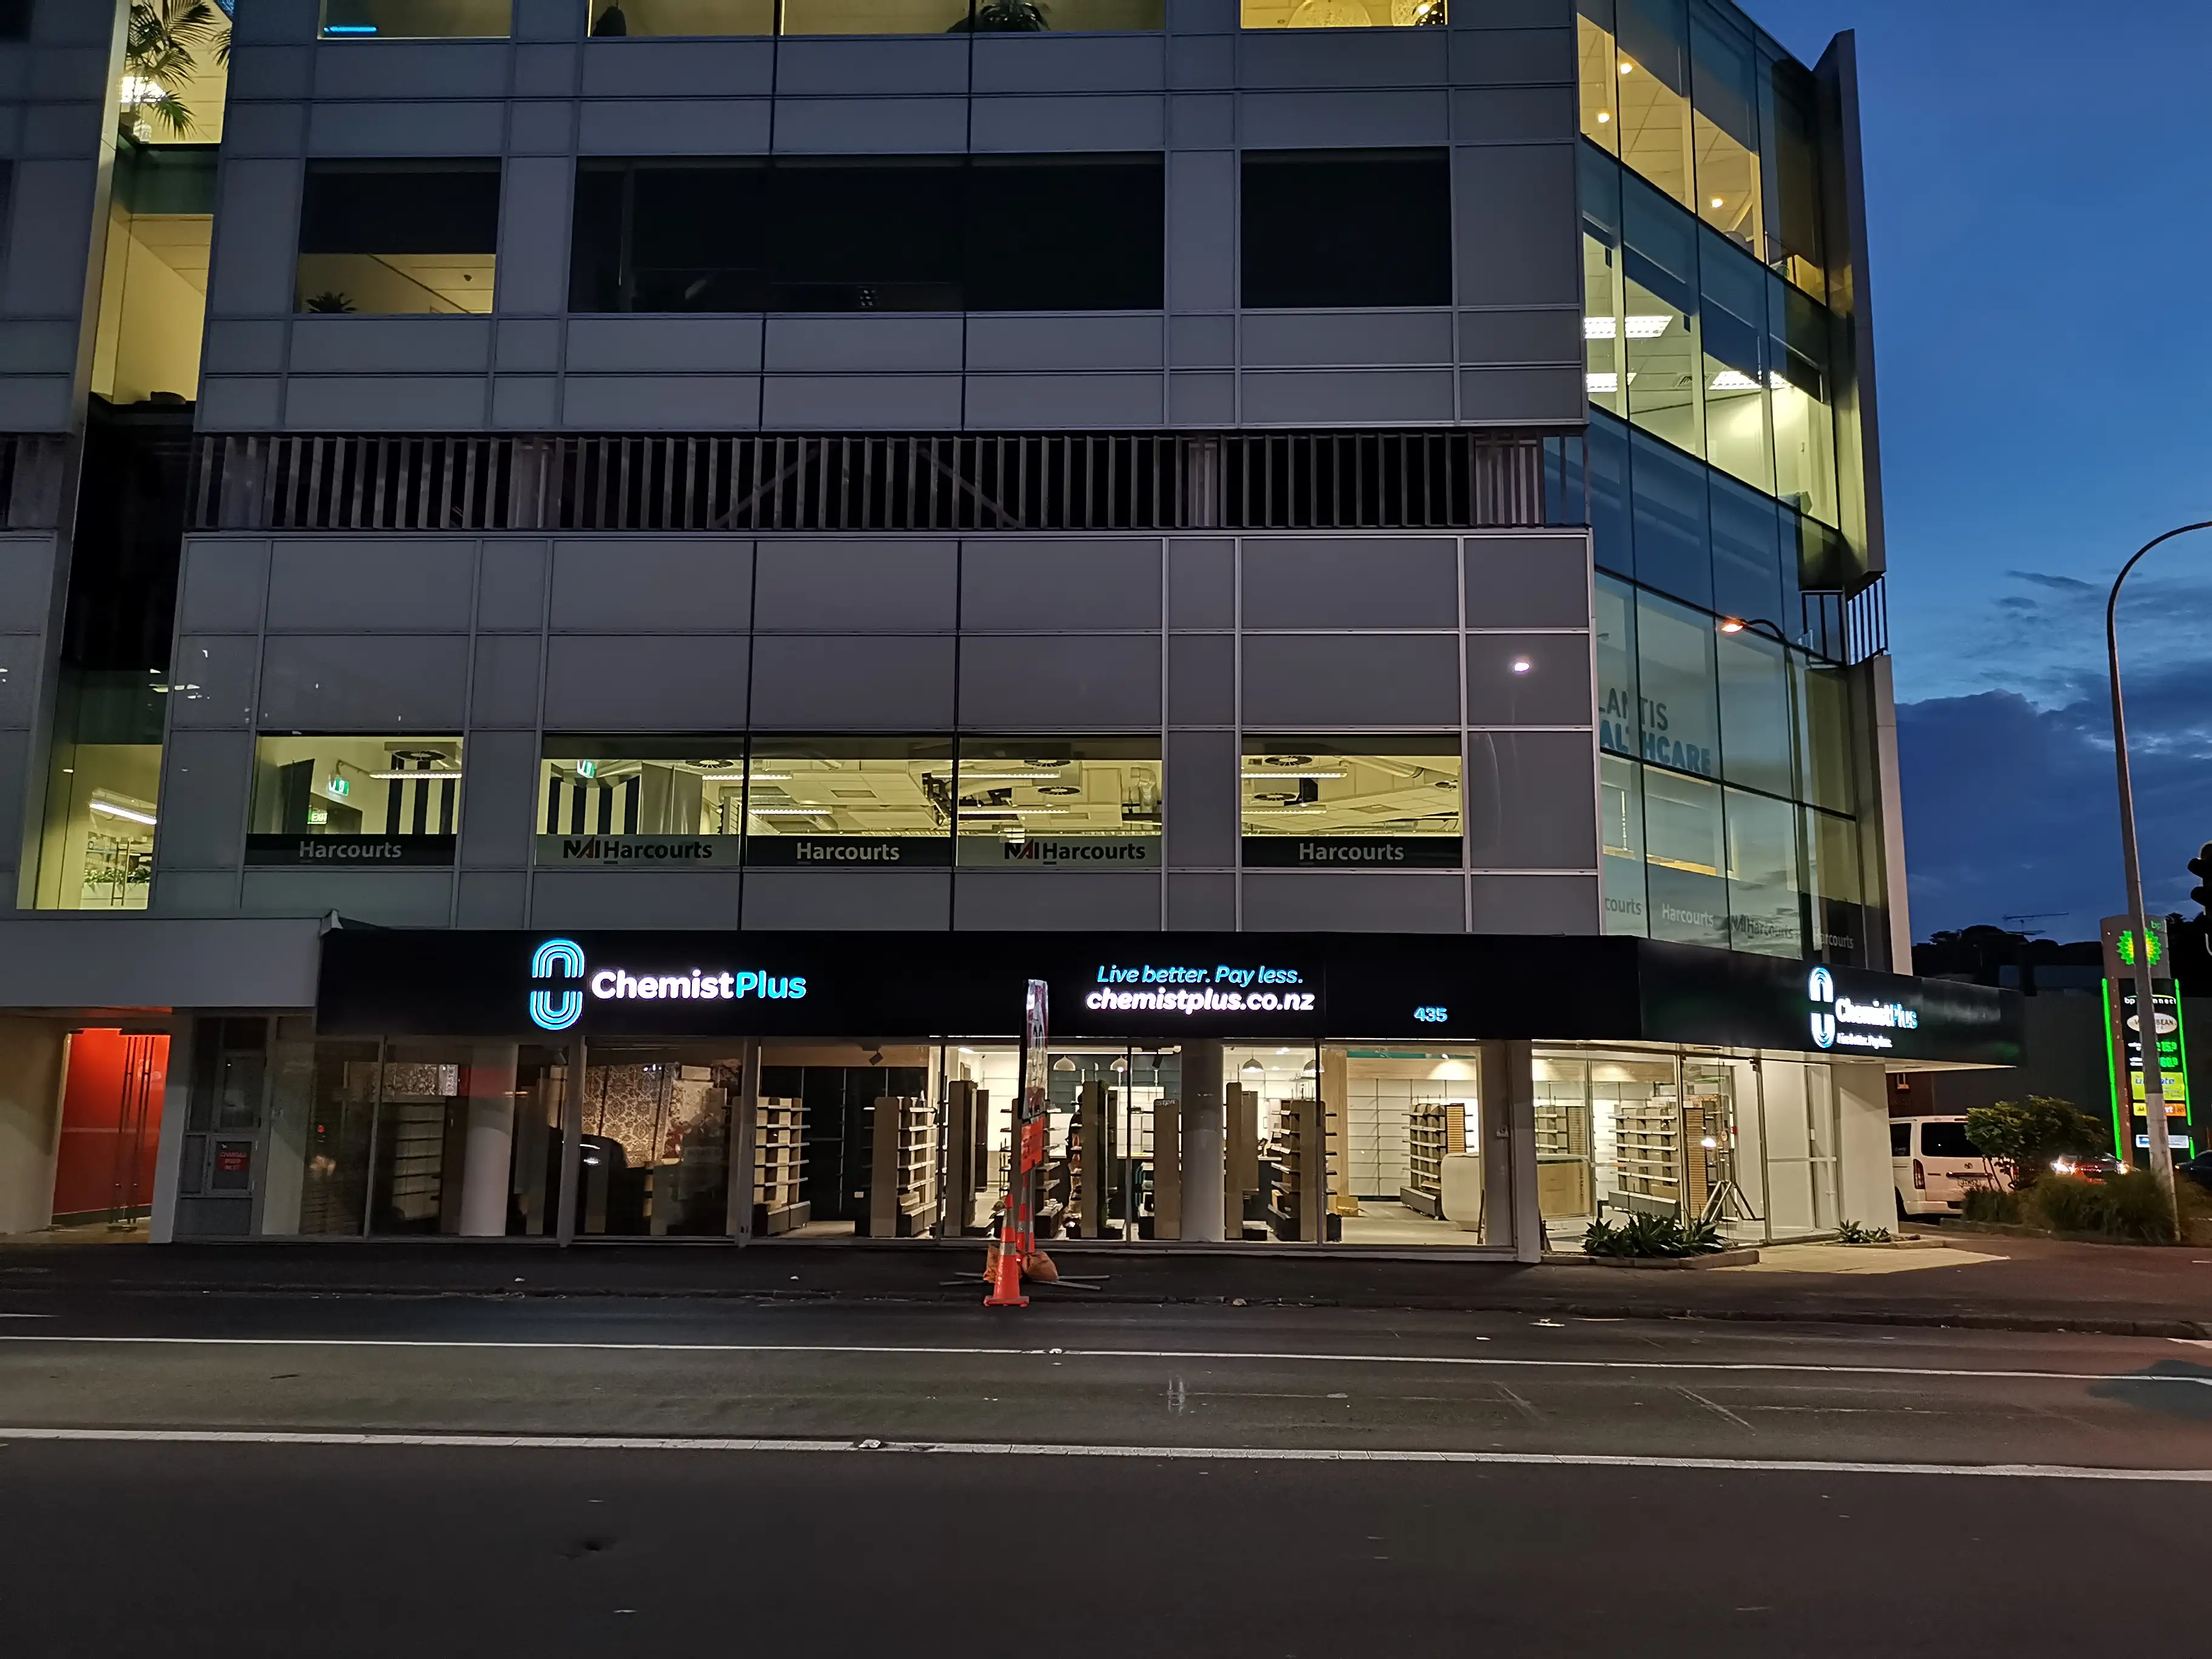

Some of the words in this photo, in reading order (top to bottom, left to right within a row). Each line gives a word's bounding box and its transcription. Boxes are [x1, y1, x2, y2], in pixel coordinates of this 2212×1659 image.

[299, 840, 402, 858] Harcourts
[604, 840, 712, 859] Harcourts
[797, 842, 900, 860] Harcourts
[1043, 842, 1145, 859] Harcourts
[1299, 843, 1404, 860] Harcourts
[1662, 903, 1714, 927] Harcourts
[591, 969, 807, 999] ChemistPlus
[1096, 965, 1137, 983] Live
[1142, 965, 1210, 983] better.
[1215, 966, 1255, 987] Pay
[1258, 965, 1304, 984] less.
[1087, 987, 1316, 1014] chemistplus.co.nz
[1413, 1007, 1447, 1022] 435
